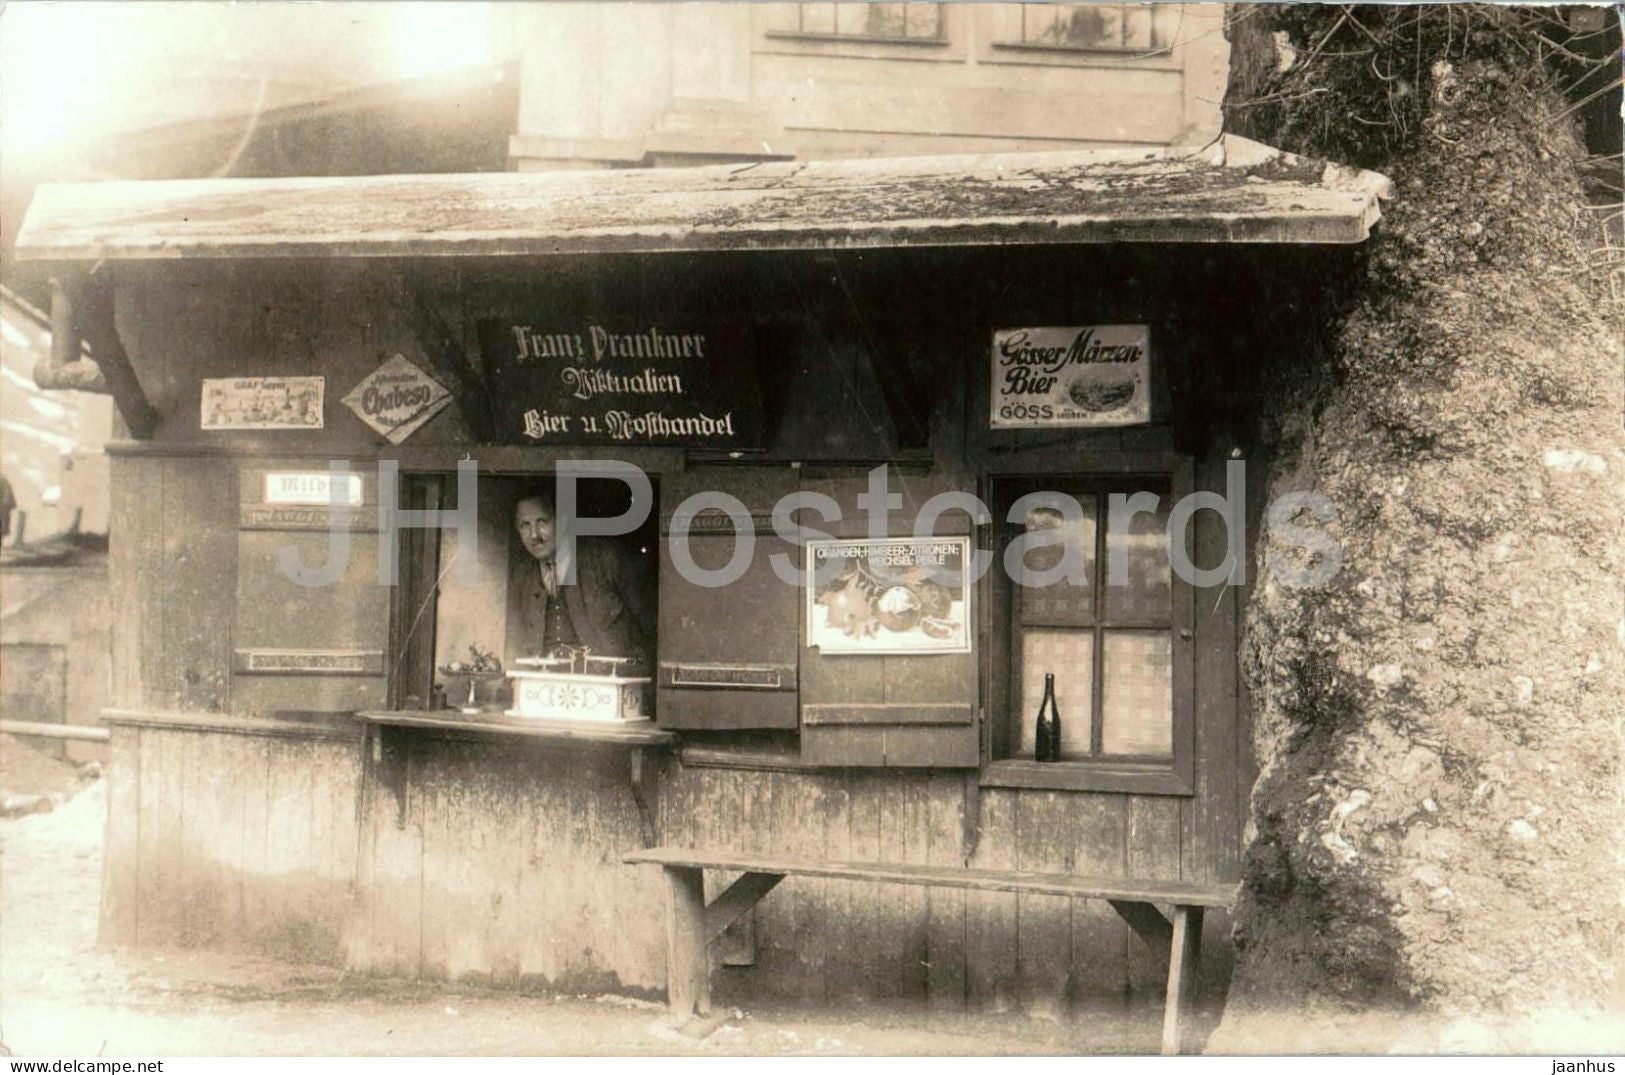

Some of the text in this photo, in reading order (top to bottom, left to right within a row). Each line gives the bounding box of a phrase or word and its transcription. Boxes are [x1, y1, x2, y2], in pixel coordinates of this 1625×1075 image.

[512, 325, 706, 361] Franz Prankner
[1000, 332, 1067, 366] Gösser
[561, 367, 683, 400] Viktualien
[1001, 366, 1057, 395] Bier
[361, 383, 431, 416] Chabeso
[1001, 402, 1053, 419] GÖSS
[523, 408, 735, 440] Bier u. Mosthandel
